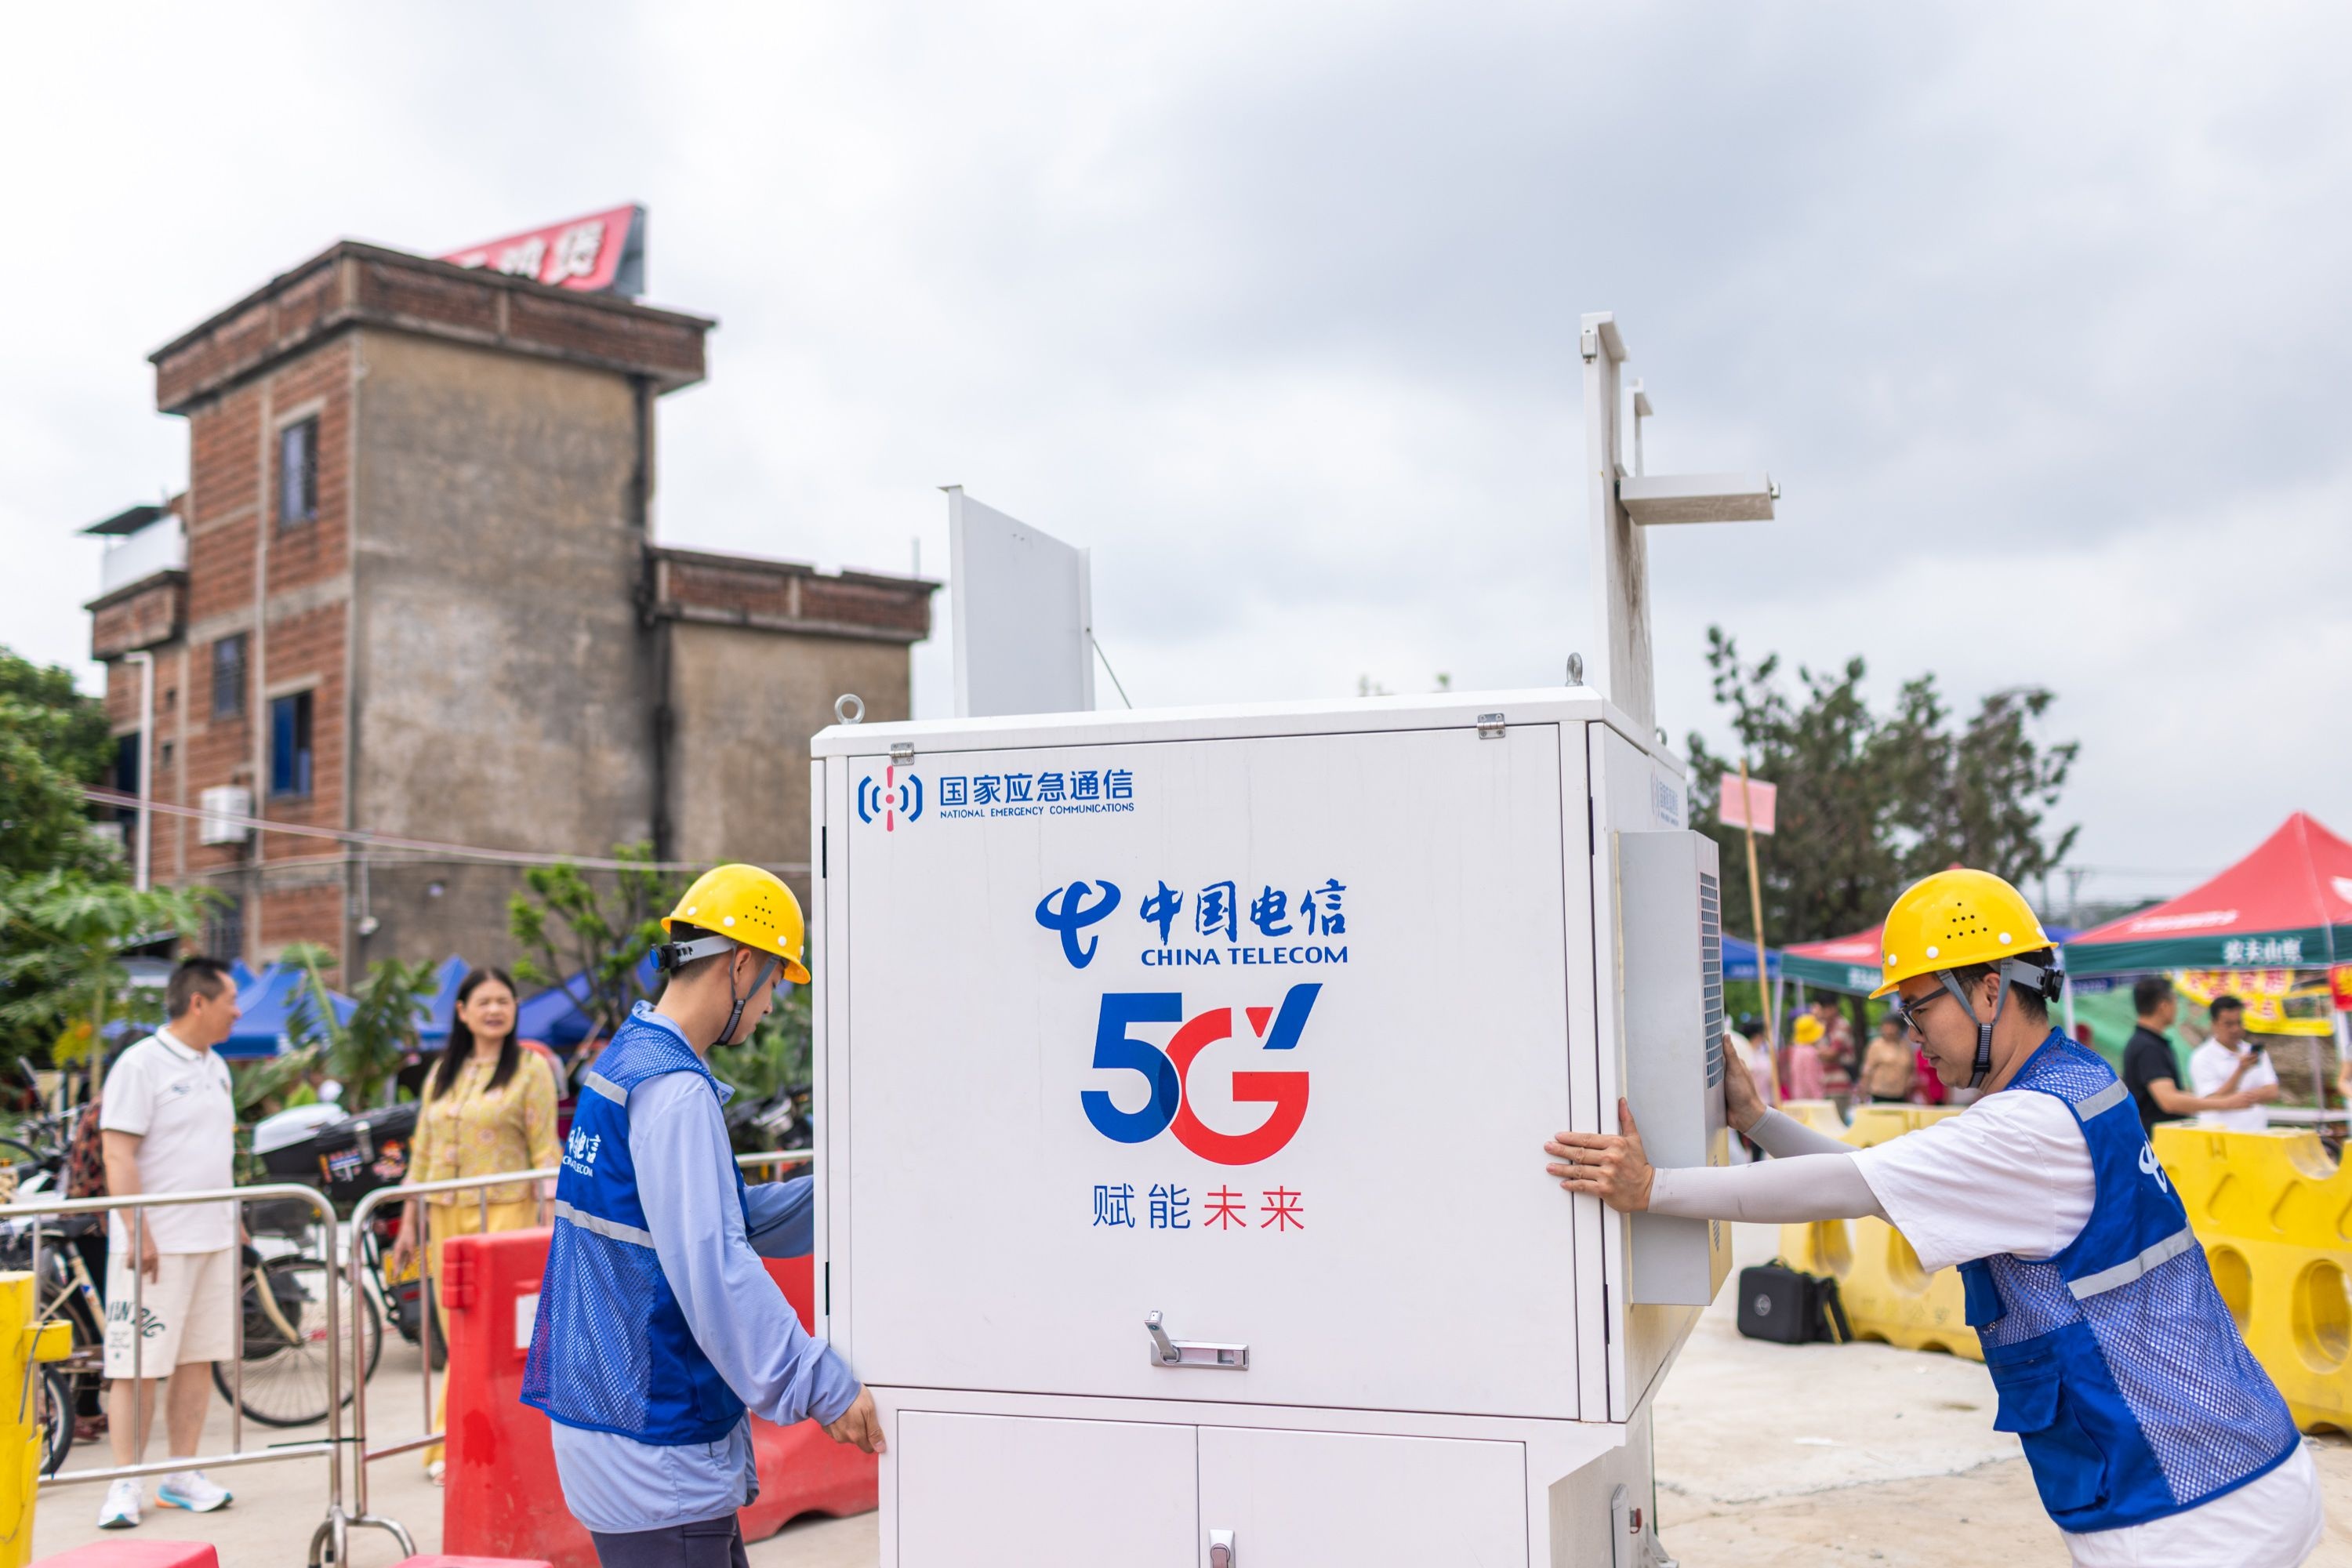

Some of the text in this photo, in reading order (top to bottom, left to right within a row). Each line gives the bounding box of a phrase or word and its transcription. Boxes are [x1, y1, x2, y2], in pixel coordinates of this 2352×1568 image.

[940, 769, 1133, 805] 国家应急通信
[940, 802, 1134, 818] NATIONAL EMERGENCY COMMUNICATIONS
[1139, 877, 1347, 946] 中国电信
[1141, 946, 1348, 967] CHINA TELECOM
[1080, 982, 1323, 1166] 5G
[1092, 1182, 1305, 1232] 赋能未来
